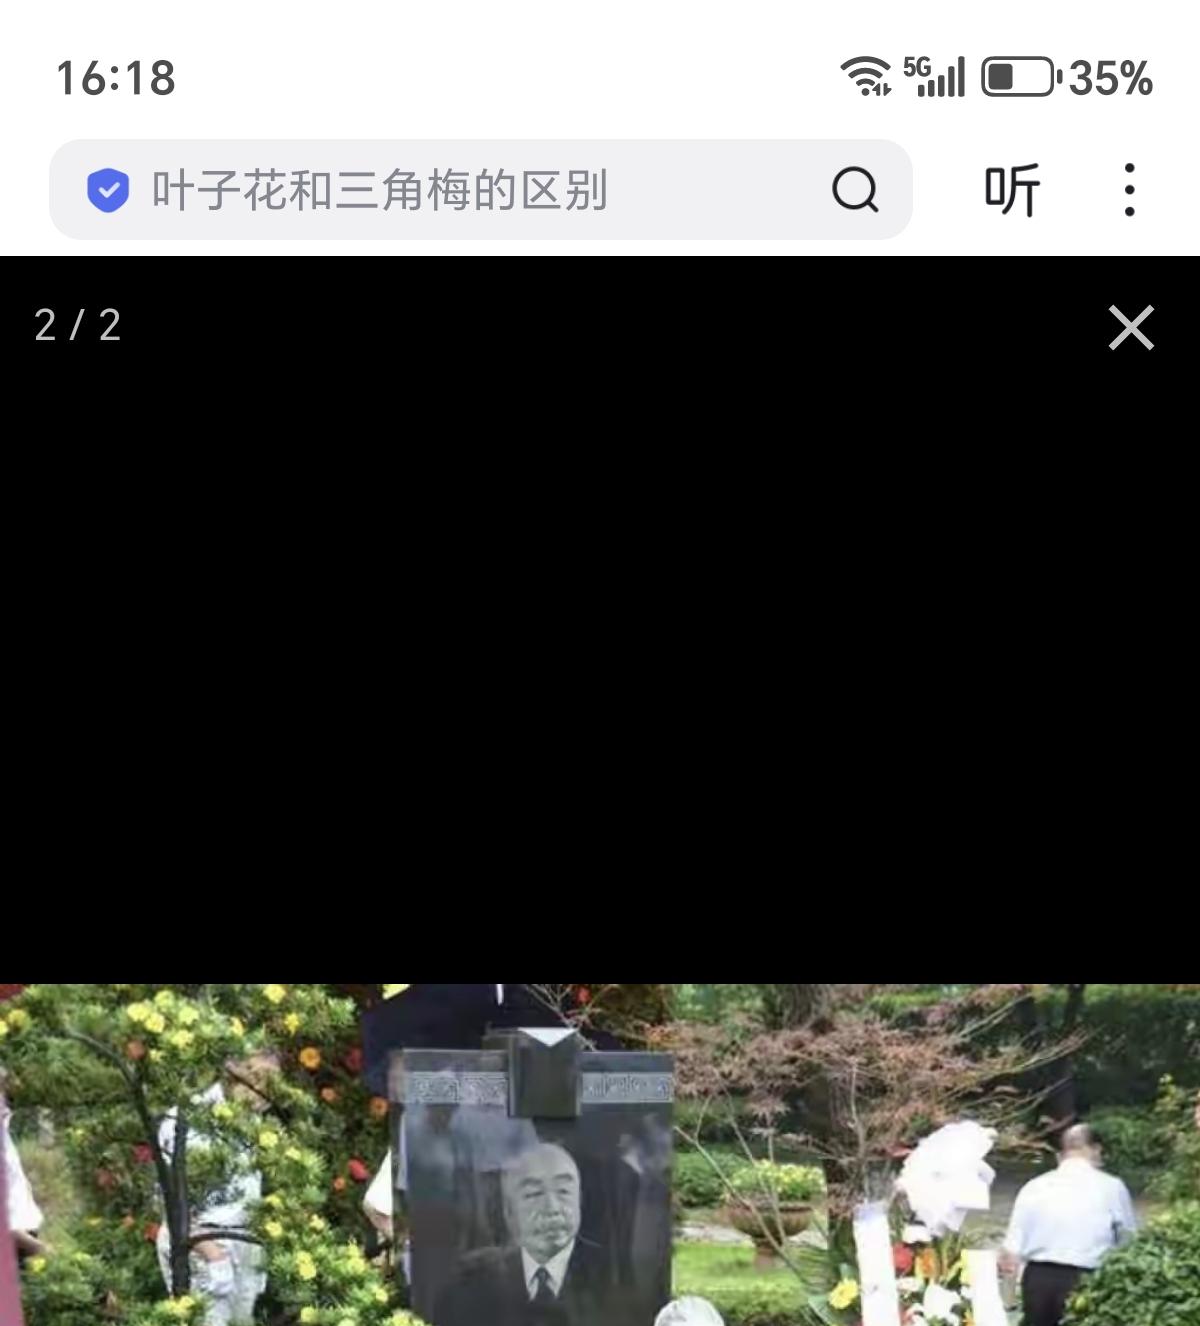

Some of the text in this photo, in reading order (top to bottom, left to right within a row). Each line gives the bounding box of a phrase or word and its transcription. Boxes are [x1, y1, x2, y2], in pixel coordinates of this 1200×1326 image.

[58, 60, 175, 96] 16:18
[903, 56, 931, 77] 5G
[1069, 60, 1154, 96] 35%
[153, 167, 608, 213] 叶子花和三角梅的区别
[985, 163, 1041, 217] 听
[34, 308, 121, 341] 2 / 2
